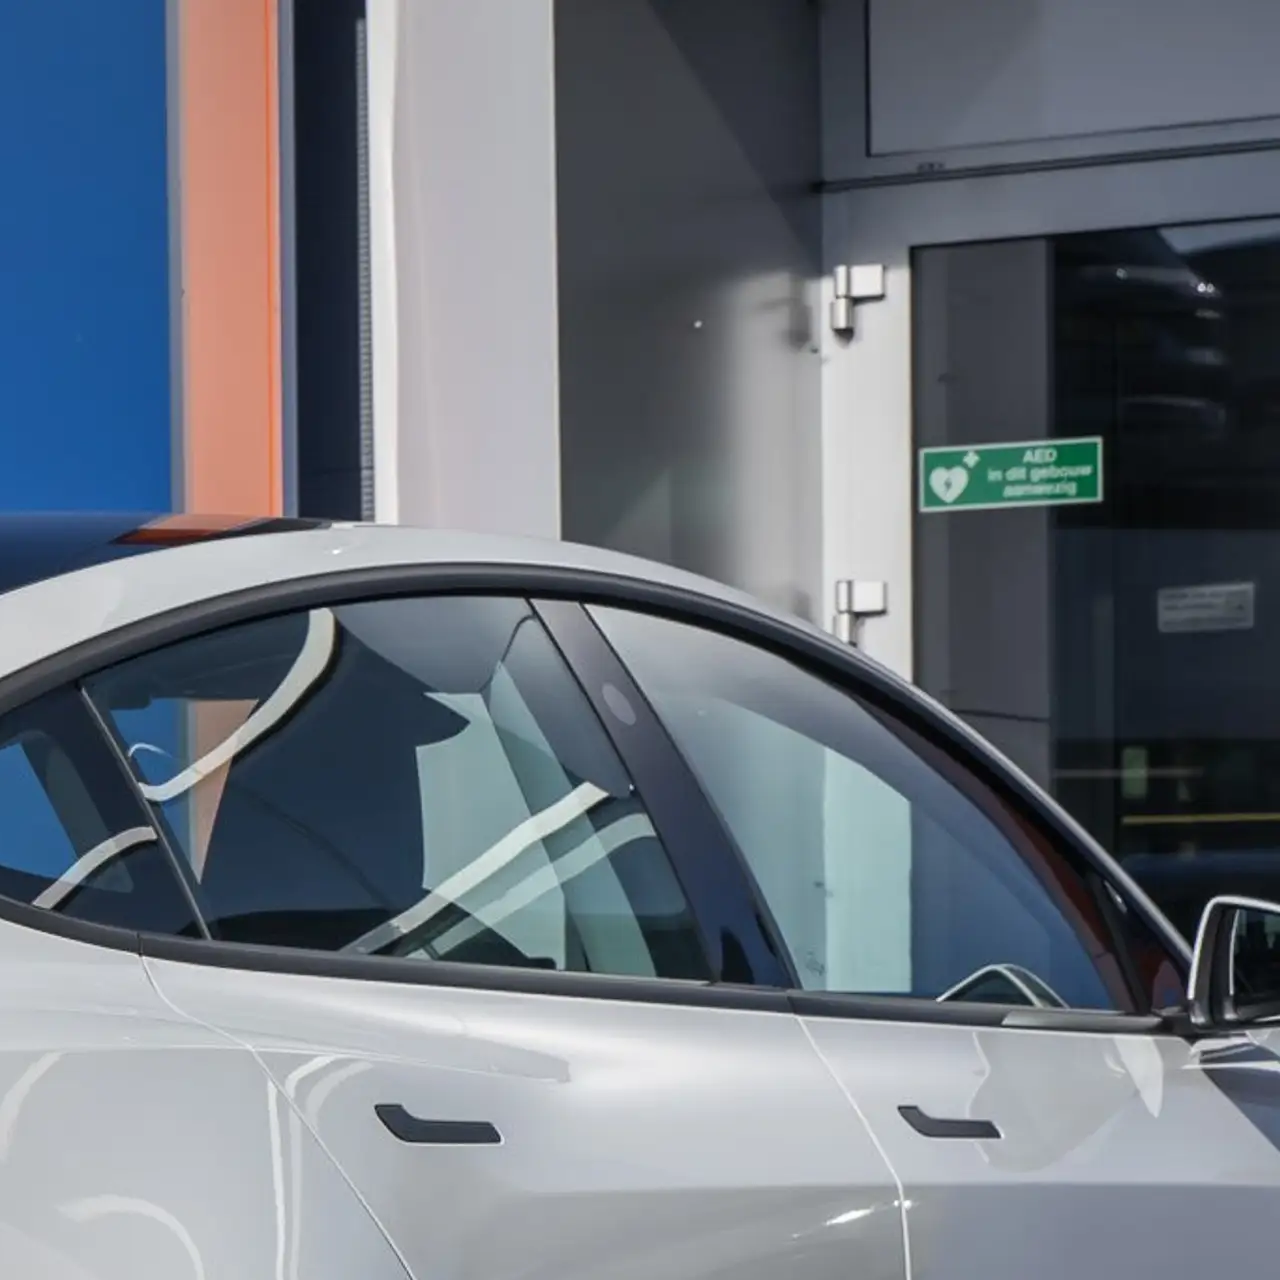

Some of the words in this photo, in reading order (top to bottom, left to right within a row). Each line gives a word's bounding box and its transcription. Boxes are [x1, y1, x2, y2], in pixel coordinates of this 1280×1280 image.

[1023, 448, 1057, 464] AED
[987, 468, 1003, 482] in
[1005, 466, 1027, 481] dit
